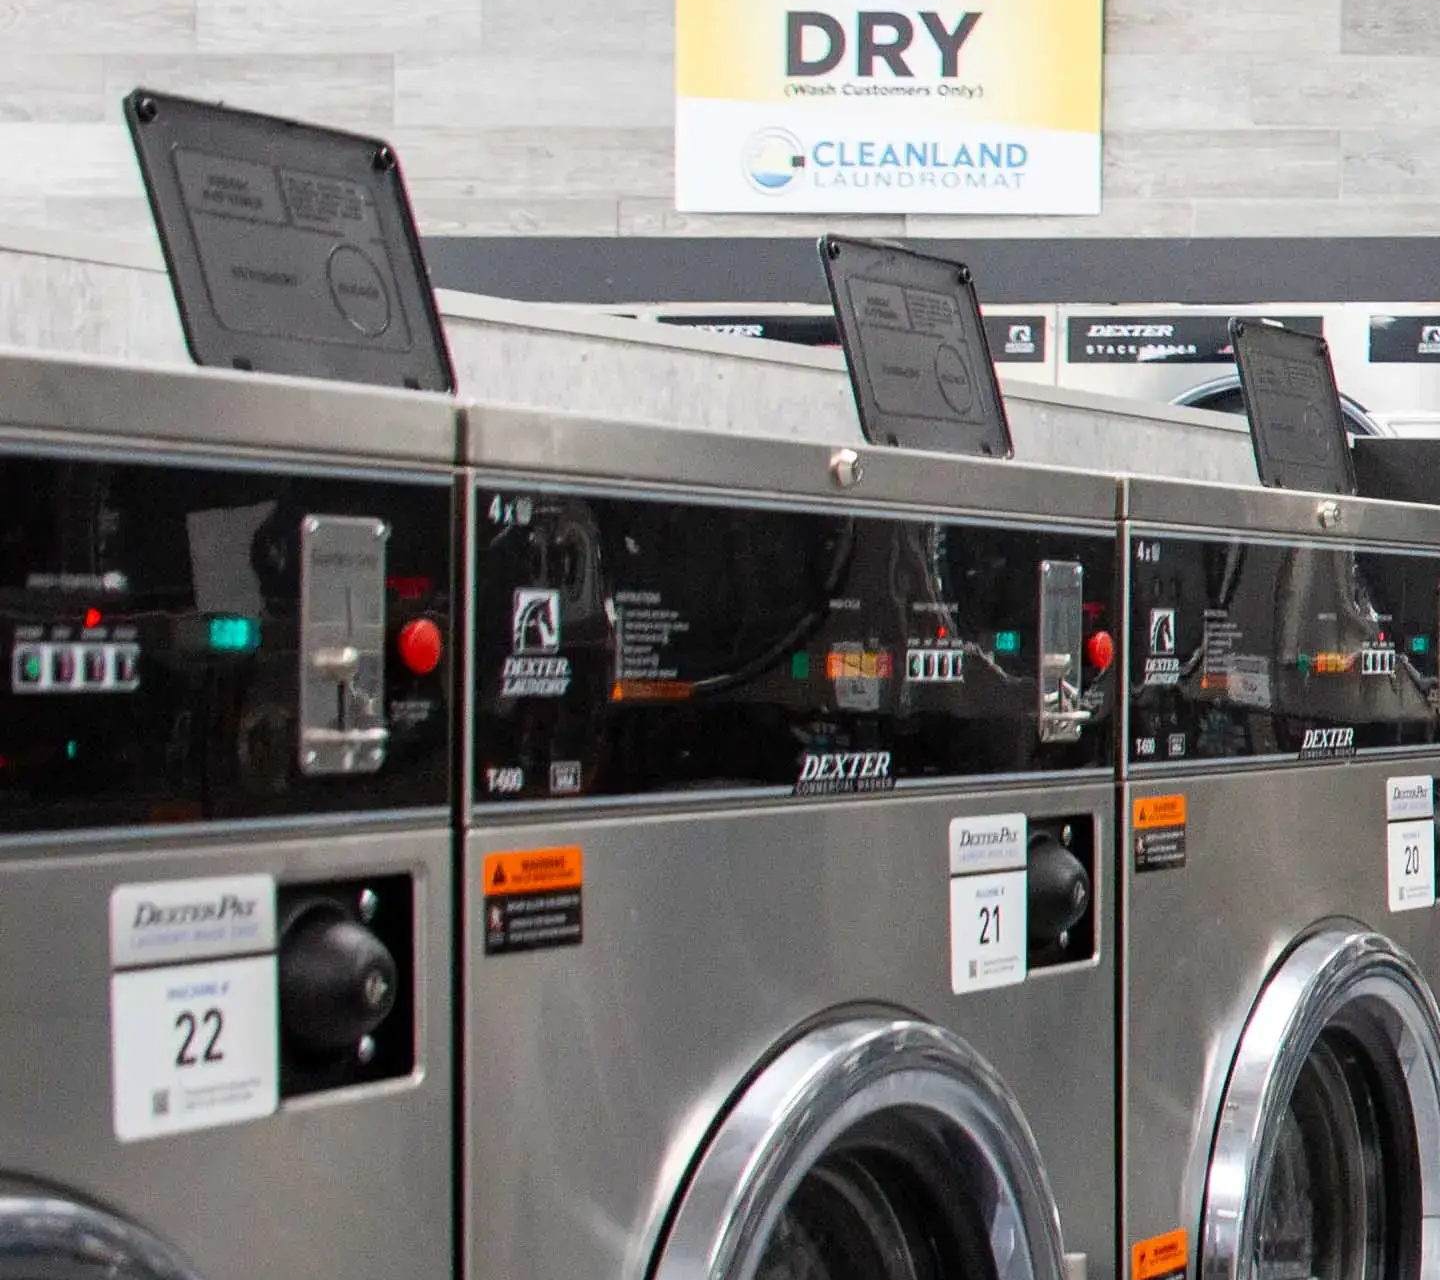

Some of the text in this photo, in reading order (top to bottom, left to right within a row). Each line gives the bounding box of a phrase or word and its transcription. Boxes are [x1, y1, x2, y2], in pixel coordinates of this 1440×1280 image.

[785, 11, 983, 77] DRY
[784, 83, 984, 99] (Wash Customers Only)
[812, 142, 1028, 168] CLEANLAND
[814, 171, 1026, 189] LAUNDROMAT
[1087, 325, 1174, 337] DEXTER
[503, 657, 572, 677] DEXTER
[1302, 728, 1355, 748] DEXTER
[800, 752, 891, 781] DEXTER
[1404, 845, 1420, 876] 20
[979, 904, 1001, 945] 21
[174, 1007, 225, 1068] 22
